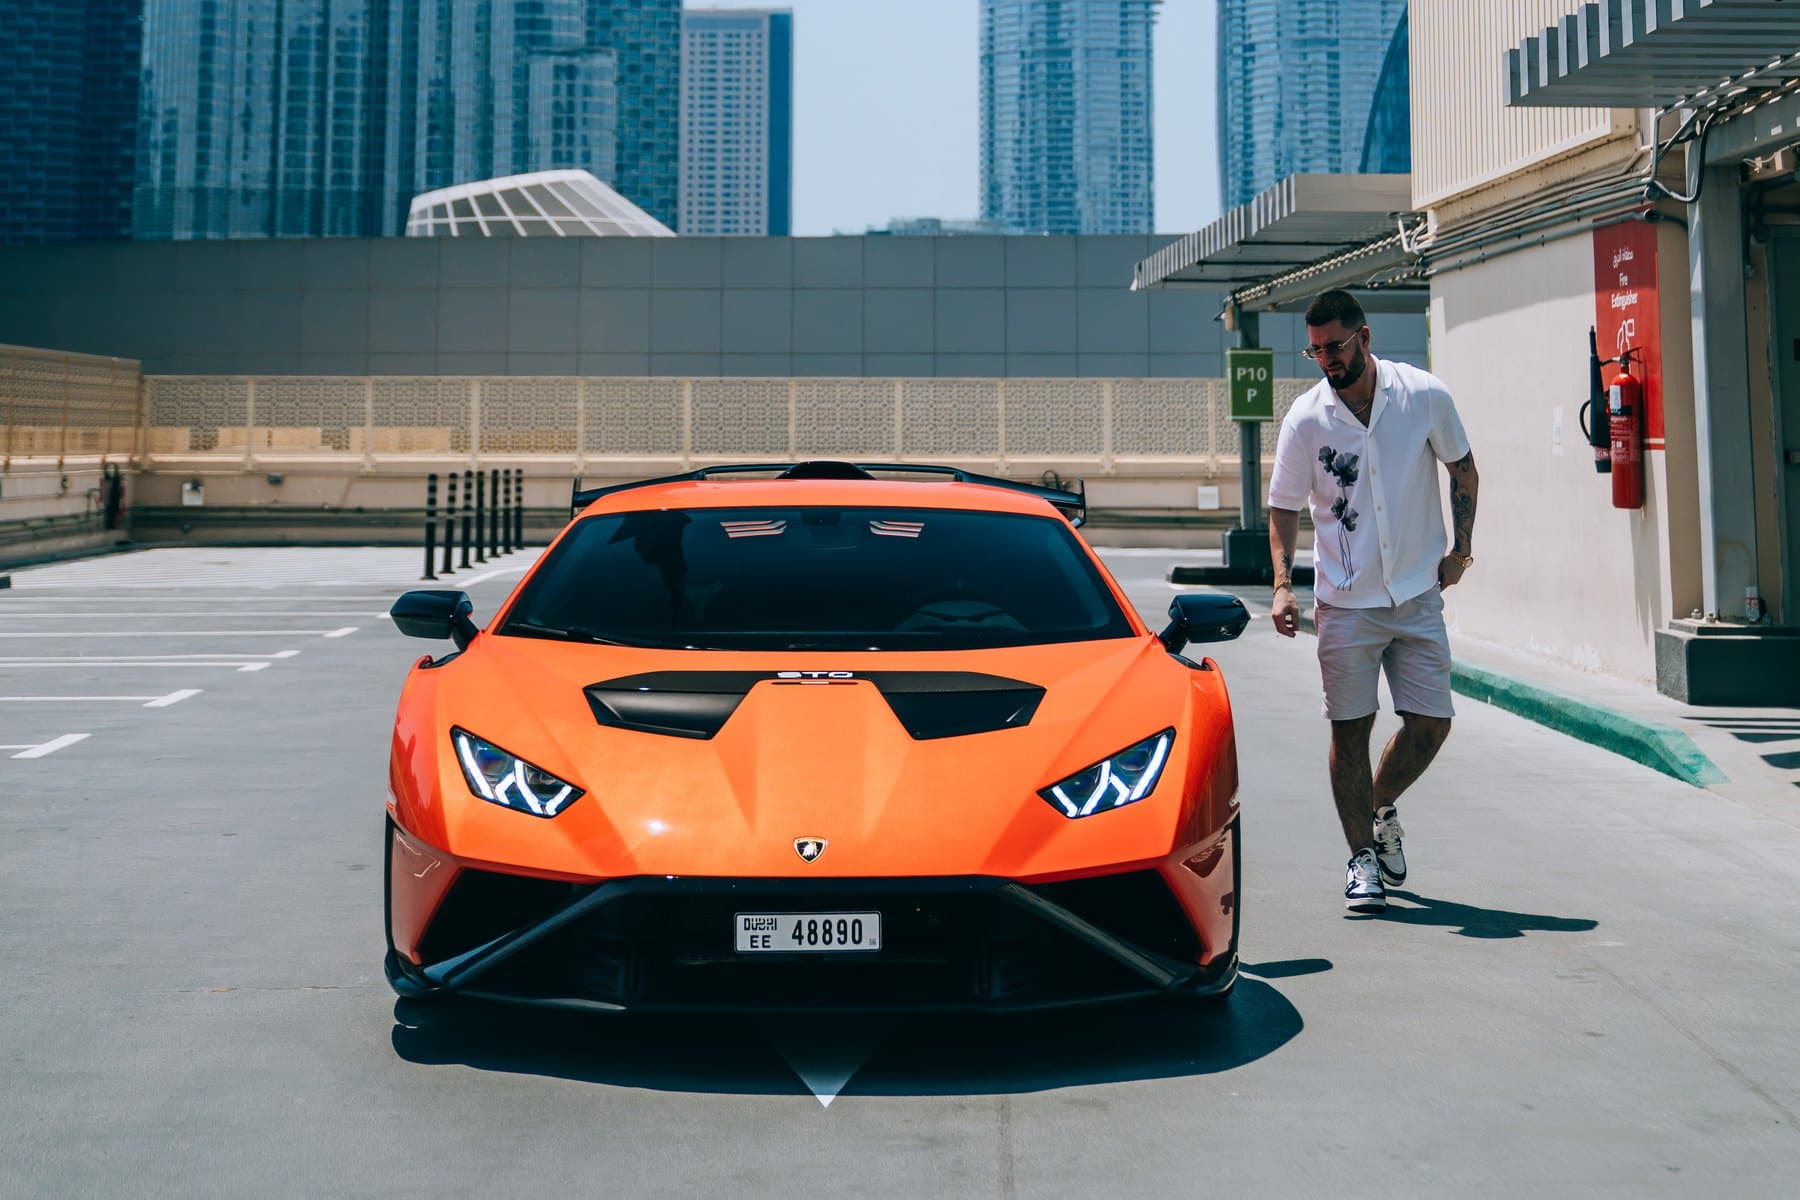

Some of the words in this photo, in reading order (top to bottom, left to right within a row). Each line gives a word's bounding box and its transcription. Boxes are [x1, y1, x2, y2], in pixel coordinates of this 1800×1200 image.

[1619, 272, 1629, 287] Fire
[1611, 289, 1638, 311] Extinguisher
[1236, 367, 1267, 382] P10
[1247, 388, 1258, 403] P
[777, 671, 854, 679] STO
[791, 918, 863, 946] 48890
[749, 934, 772, 949] EE
